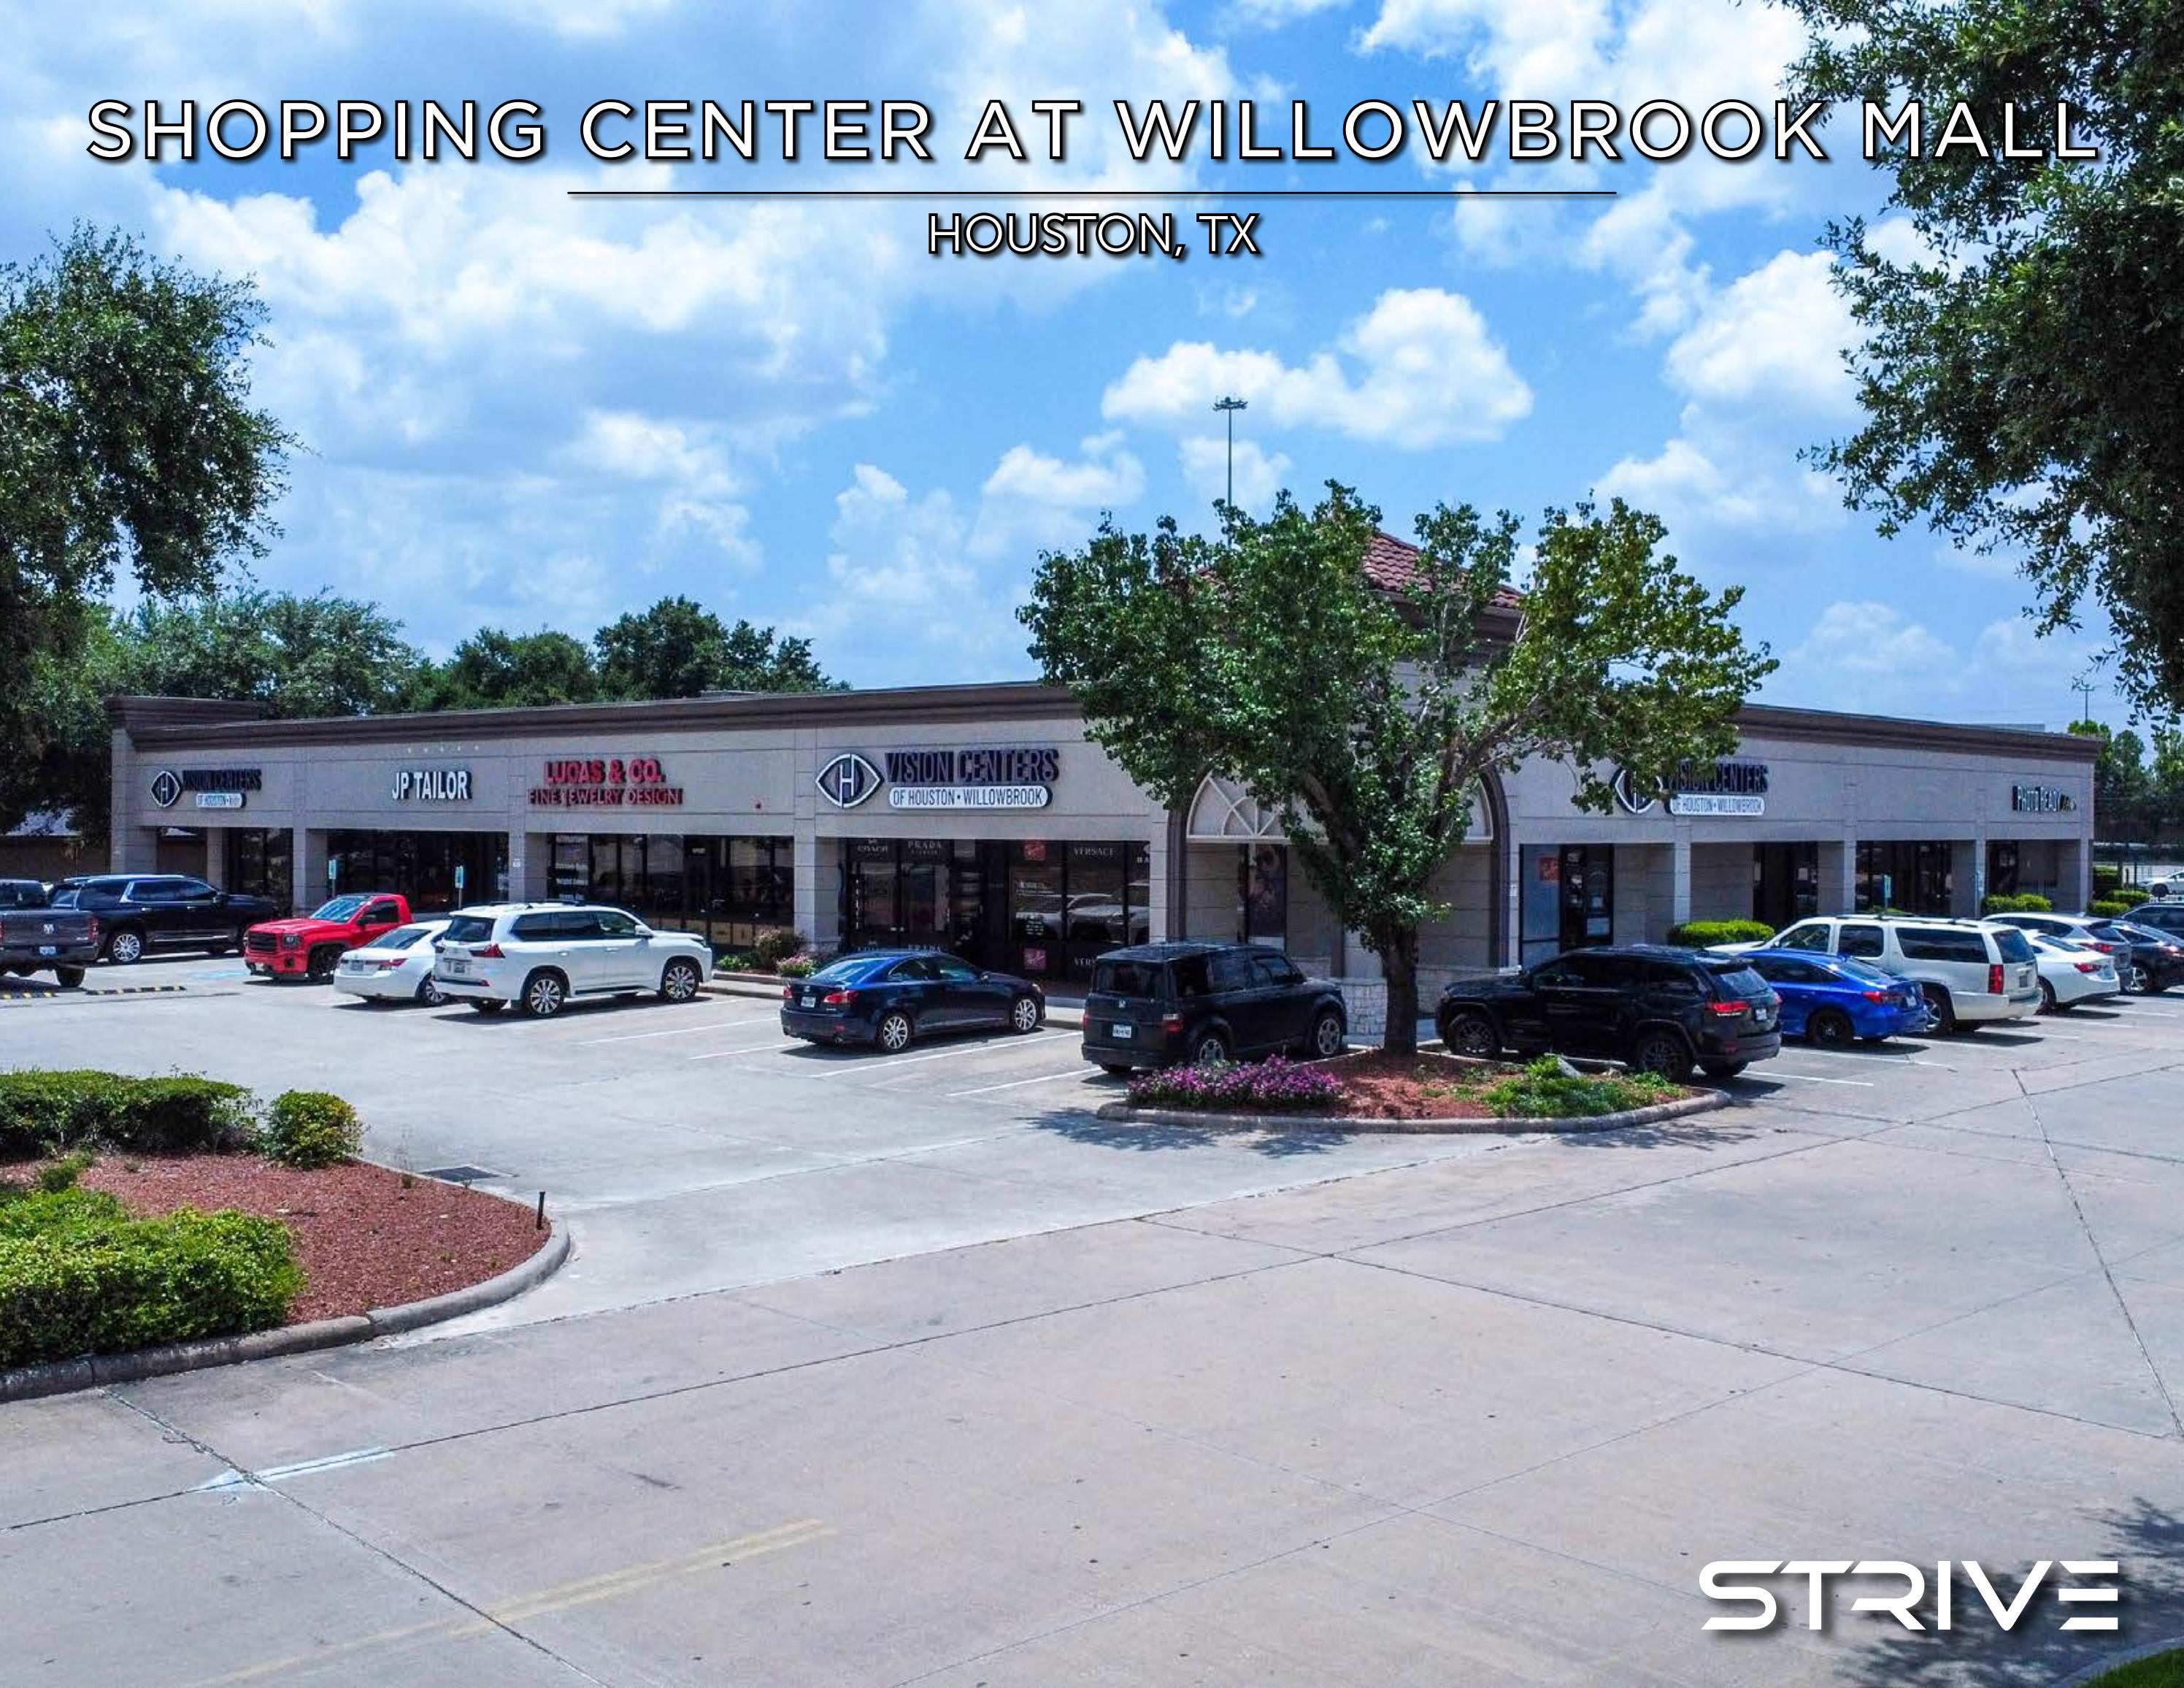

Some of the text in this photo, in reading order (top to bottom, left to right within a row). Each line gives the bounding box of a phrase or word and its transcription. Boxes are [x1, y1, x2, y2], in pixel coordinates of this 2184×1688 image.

[544, 759, 665, 783] LUCAS & CO.
[885, 749, 1059, 783] VISION CENTERS
[392, 771, 470, 799] JP TAILOR
[1715, 763, 1768, 793] CENTERS
[527, 788, 683, 806] FINE JEWELRY DESIGN
[893, 789, 1042, 806] OF HOUSTON WILLOWBROOK
[907, 840, 942, 849] PRADA
[1073, 848, 1115, 856] VERSACE
